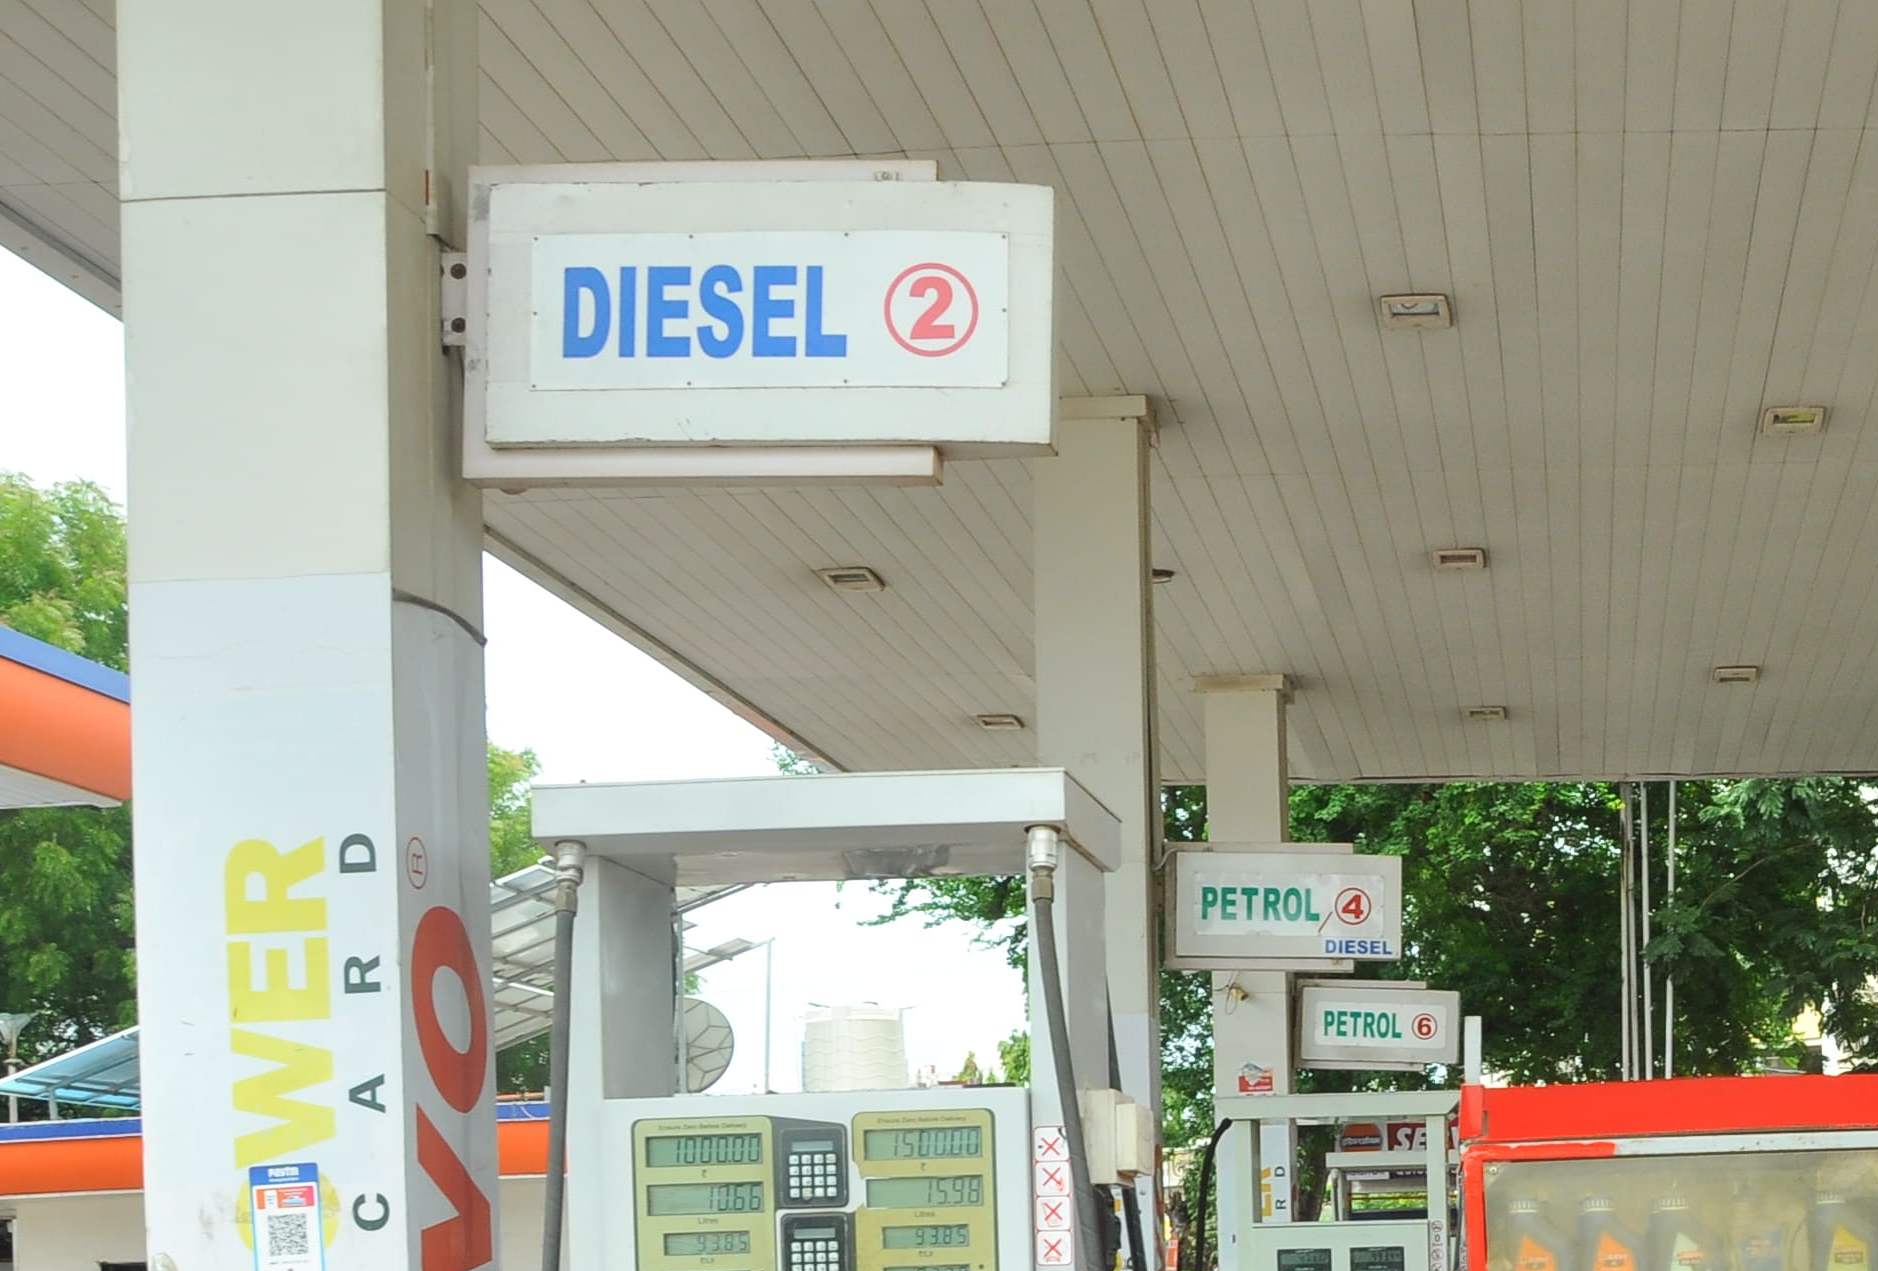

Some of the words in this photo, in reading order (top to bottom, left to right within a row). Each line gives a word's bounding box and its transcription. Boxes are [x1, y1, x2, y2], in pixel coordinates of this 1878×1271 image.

[562, 264, 848, 359] DIESEL
[1200, 886, 1320, 923] PETROL
[1324, 939, 1393, 956] DIESEL
[339, 833, 391, 1232] CARD
[1323, 1009, 1403, 1040] PETROL
